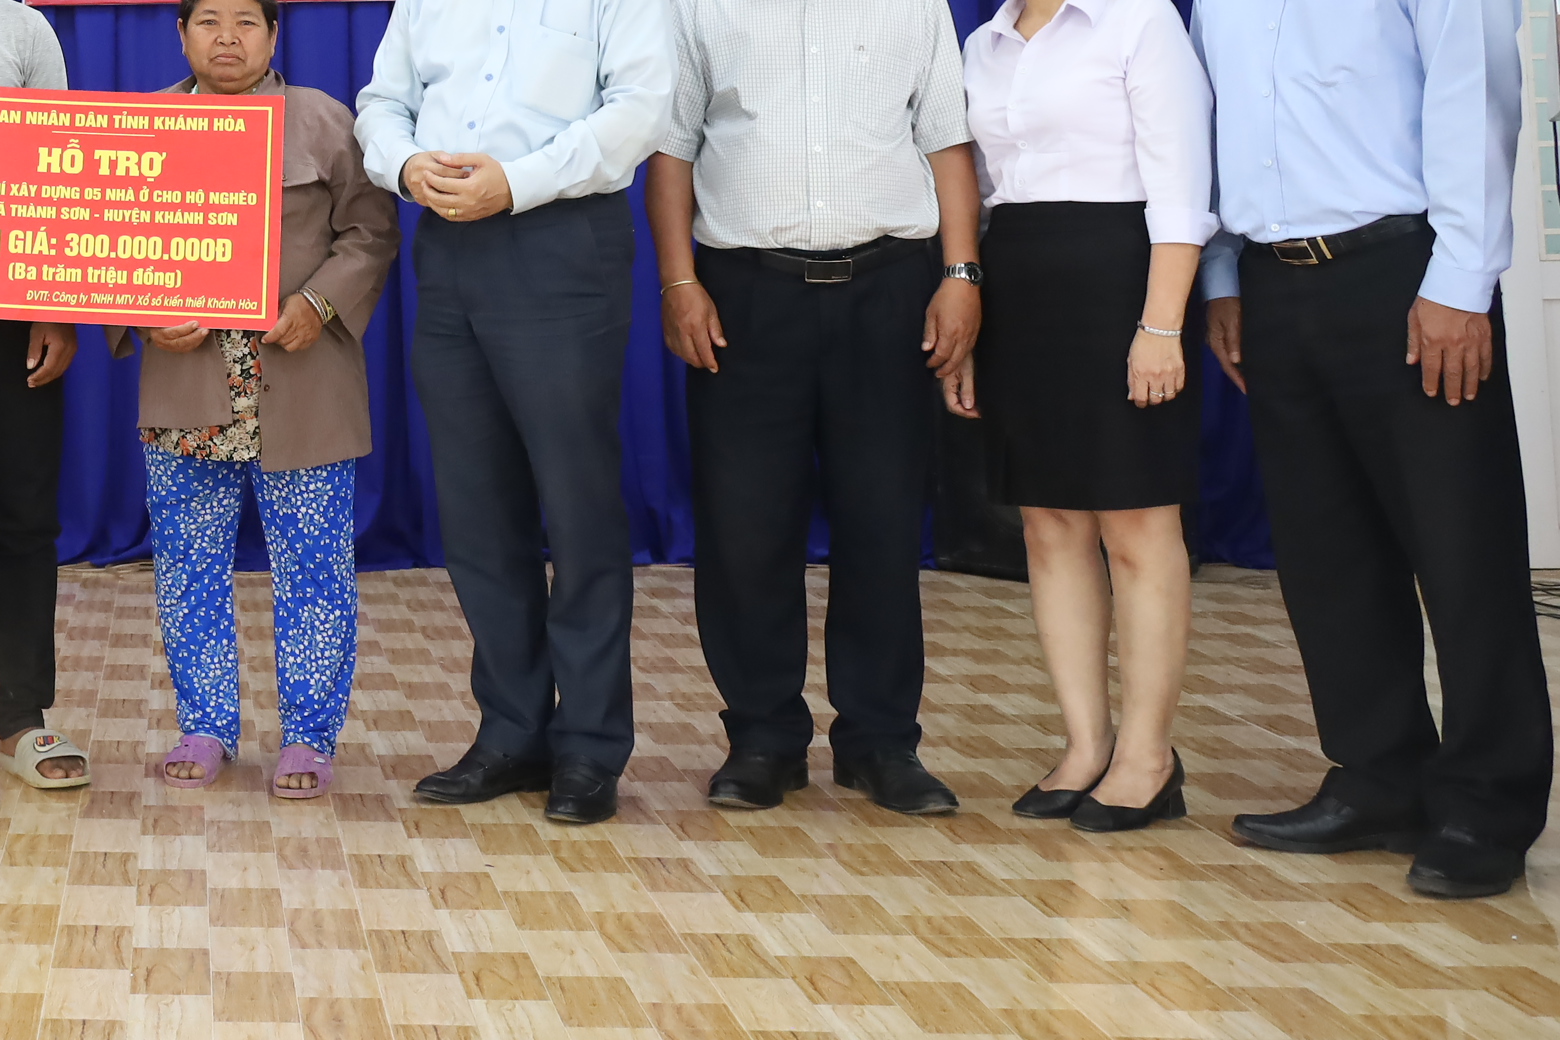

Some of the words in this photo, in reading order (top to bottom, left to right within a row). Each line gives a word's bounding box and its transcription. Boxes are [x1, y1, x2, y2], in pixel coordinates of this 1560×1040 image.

[25, 109, 71, 127] NHÂN
[74, 110, 109, 129] DÂN
[112, 110, 150, 130] TỈNH
[153, 114, 209, 132] KHÁNH
[212, 114, 247, 133] HÒA
[36, 138, 85, 175] HỖ
[93, 149, 167, 183] TRỢ
[9, 181, 39, 198] XÂY
[40, 184, 81, 202] DỰNG
[83, 187, 102, 201] 05
[105, 186, 136, 202] NHÀ
[138, 185, 150, 203] Ở
[152, 189, 182, 204] CHO
[185, 188, 206, 207] HỘ
[208, 189, 258, 206] NGHÈO
[9, 202, 57, 219] THÀNH
[59, 206, 91, 221] SƠN
[103, 207, 152, 226] HUYỆN
[154, 208, 205, 225] KHÁNH
[207, 211, 238, 226] SƠN
[7, 226, 58, 256] GIÁ:
[63, 232, 233, 263] 300.000.000Đ
[7, 262, 38, 281] (Ba
[41, 264, 83, 283] trăm
[86, 266, 128, 288] triệu
[132, 265, 182, 289] đồng)
[51, 290, 79, 306] Công
[78, 293, 89, 306] ty
[89, 292, 115, 305] TNHH
[114, 293, 136, 306] MTV
[135, 292, 152, 306] Xổ
[150, 293, 165, 307] số
[163, 294, 184, 308] kiến
[184, 295, 207, 309] thiết
[206, 297, 237, 310] Khánh
[237, 298, 259, 311] Hòa
